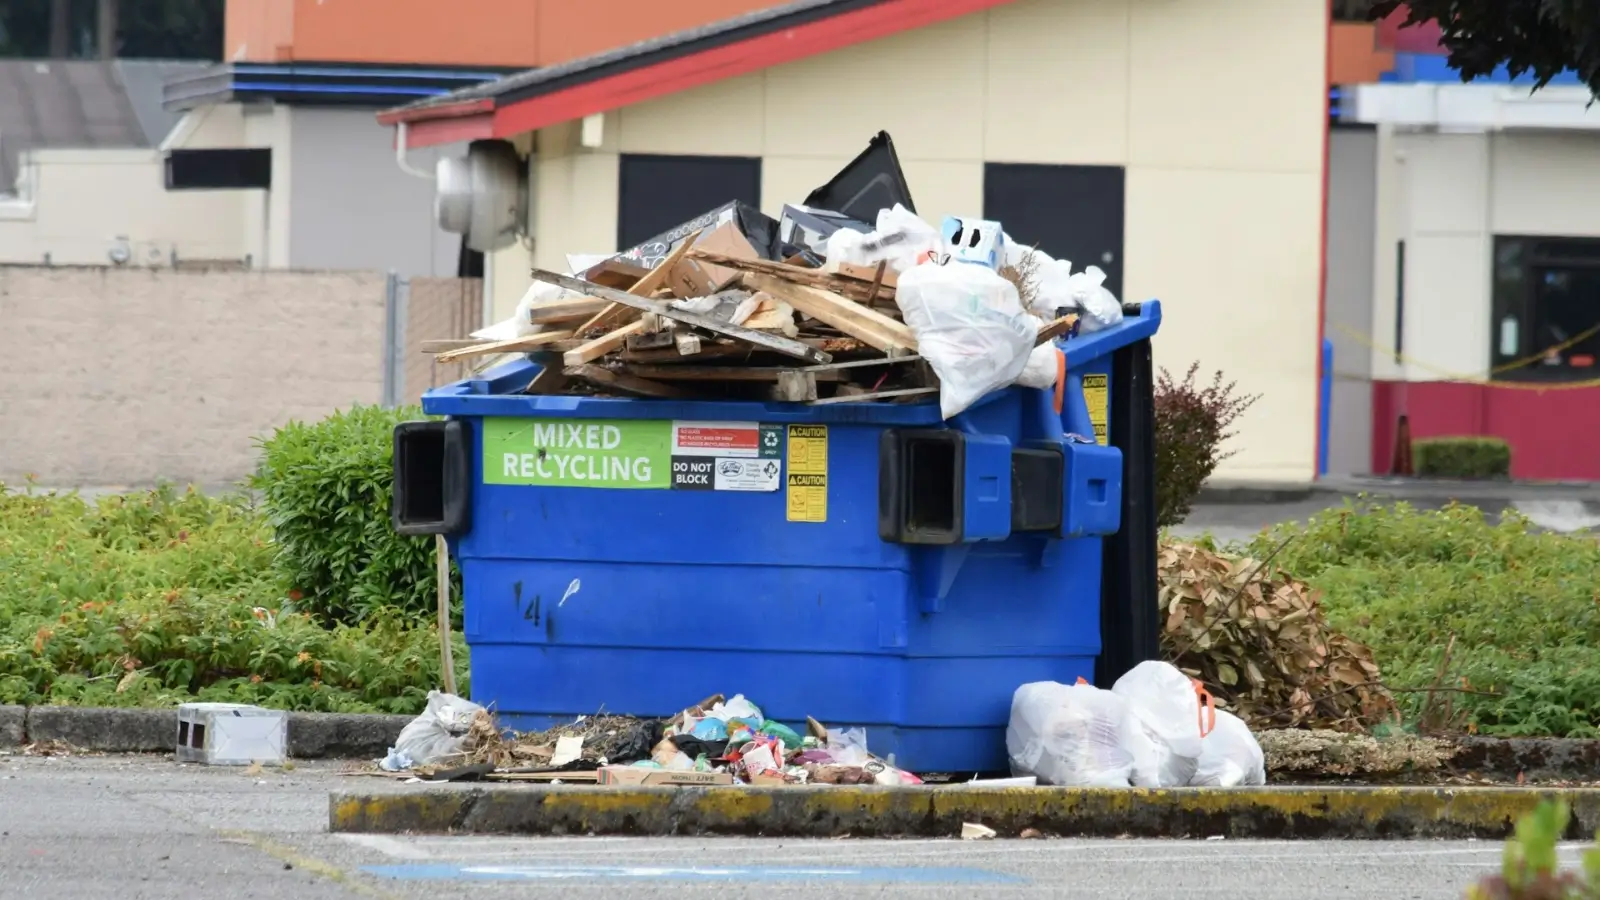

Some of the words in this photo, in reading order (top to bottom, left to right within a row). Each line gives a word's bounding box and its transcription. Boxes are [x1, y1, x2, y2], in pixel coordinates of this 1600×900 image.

[533, 423, 621, 450] MIXED
[797, 428, 825, 436] CAUTION
[503, 453, 652, 482] RECYCLING
[673, 462, 688, 472] DO
[690, 463, 712, 473] NOT
[676, 474, 709, 484] BLOCK
[797, 476, 825, 485] CAUTION
